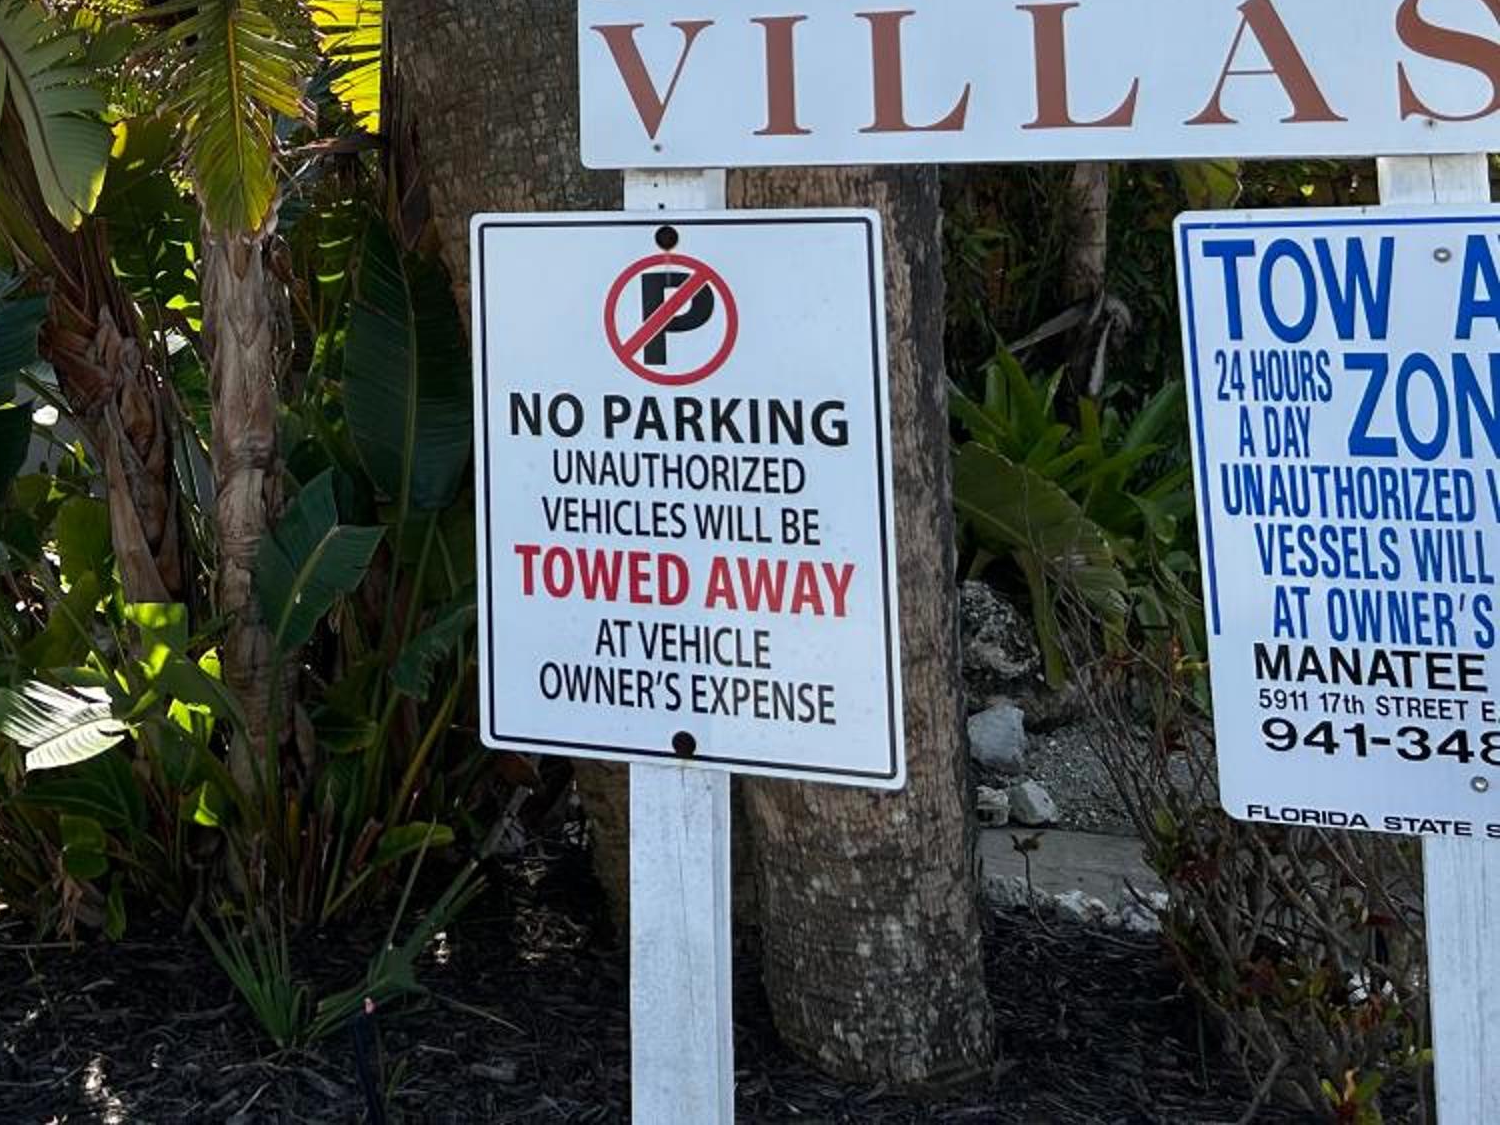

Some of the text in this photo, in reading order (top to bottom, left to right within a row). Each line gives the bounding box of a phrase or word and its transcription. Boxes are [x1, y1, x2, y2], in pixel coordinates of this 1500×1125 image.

[1202, 234, 1500, 344] TOW A
[1214, 350, 1332, 403] 24 HOURS
[509, 392, 849, 446] NO PARKING
[1238, 405, 1311, 458] A DAY
[1343, 352, 1500, 461] ZON
[553, 449, 806, 494] UNAUTHORIZED
[1220, 463, 1476, 523] UNAUTHORIZED
[542, 496, 820, 546] VEHICLES WILL BE
[1253, 522, 1495, 584] VESSELS WILL
[514, 544, 855, 618] TOWED AWAY
[595, 619, 771, 669] AT VEHICLE
[1273, 586, 1495, 650] AT OWNER'S
[539, 661, 836, 725] OWNER'S EXPENSE
[1253, 642, 1488, 693] MANATEE
[1259, 688, 1308, 712] 5911
[1319, 692, 1365, 715] 17th
[1375, 696, 1469, 721] STREET
[1261, 717, 1500, 766] 941-348
[1246, 804, 1370, 828] FLORIDA
[1384, 816, 1473, 837] STATE
